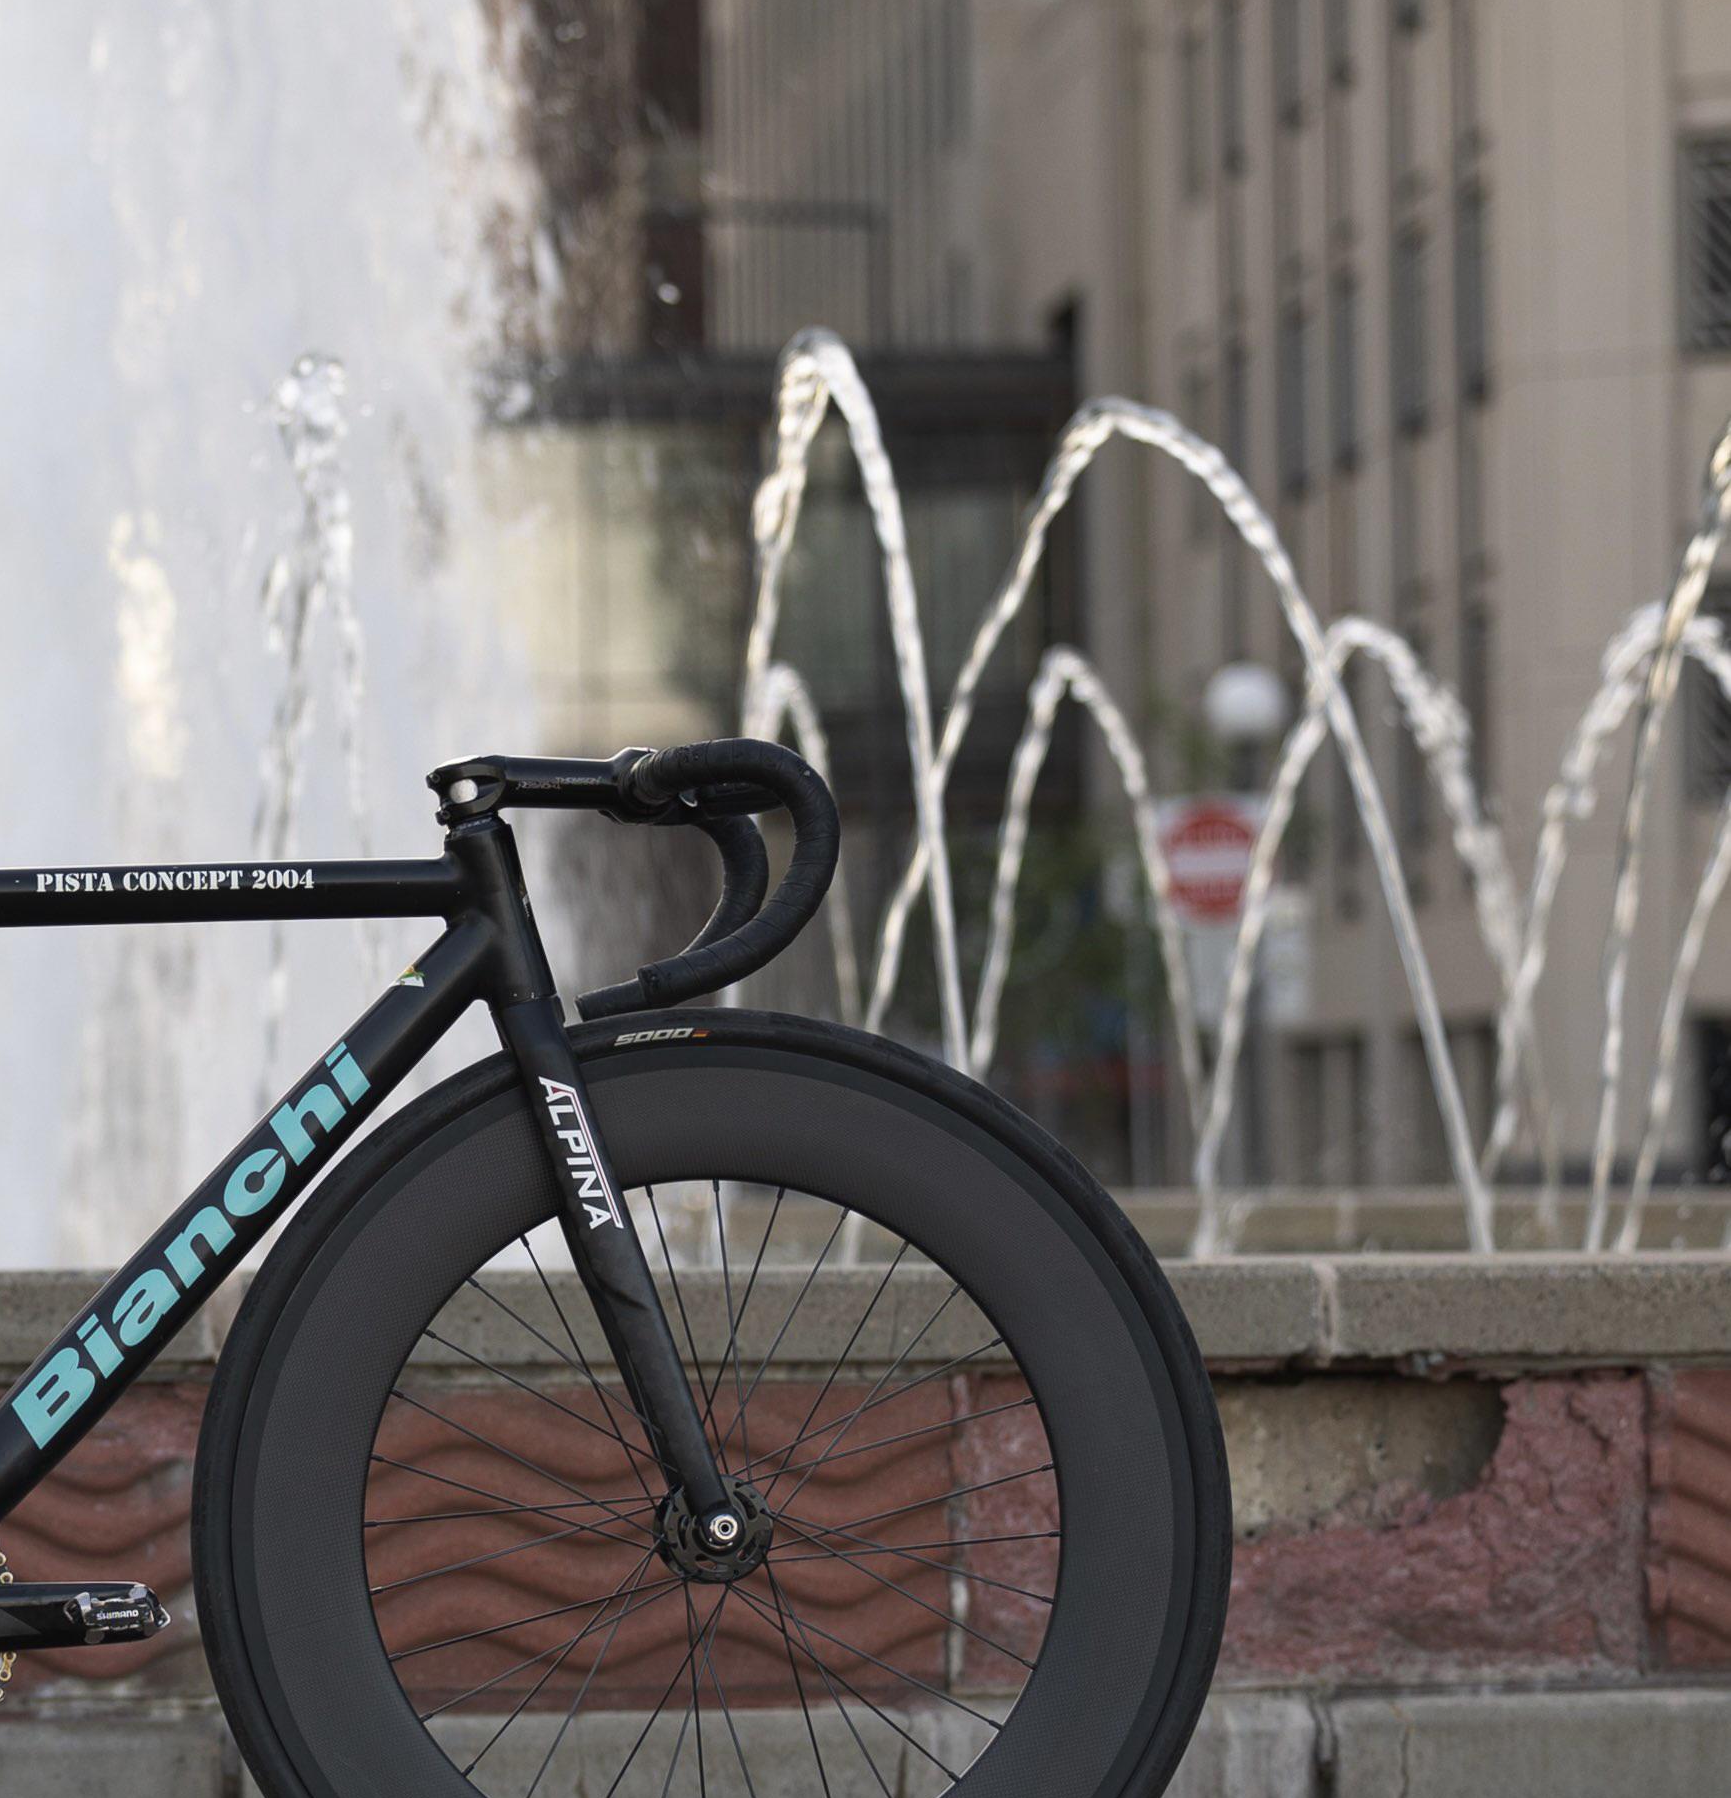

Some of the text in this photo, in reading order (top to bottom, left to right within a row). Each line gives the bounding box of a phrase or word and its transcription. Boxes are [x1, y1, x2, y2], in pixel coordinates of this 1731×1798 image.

[36, 868, 316, 893] PISTA CONCEPT 2004
[613, 1027, 694, 1047] 5000
[538, 1076, 622, 1230] ALPINA
[11, 1041, 371, 1451] Bianchi
[96, 1608, 140, 1621] SHIMANO
